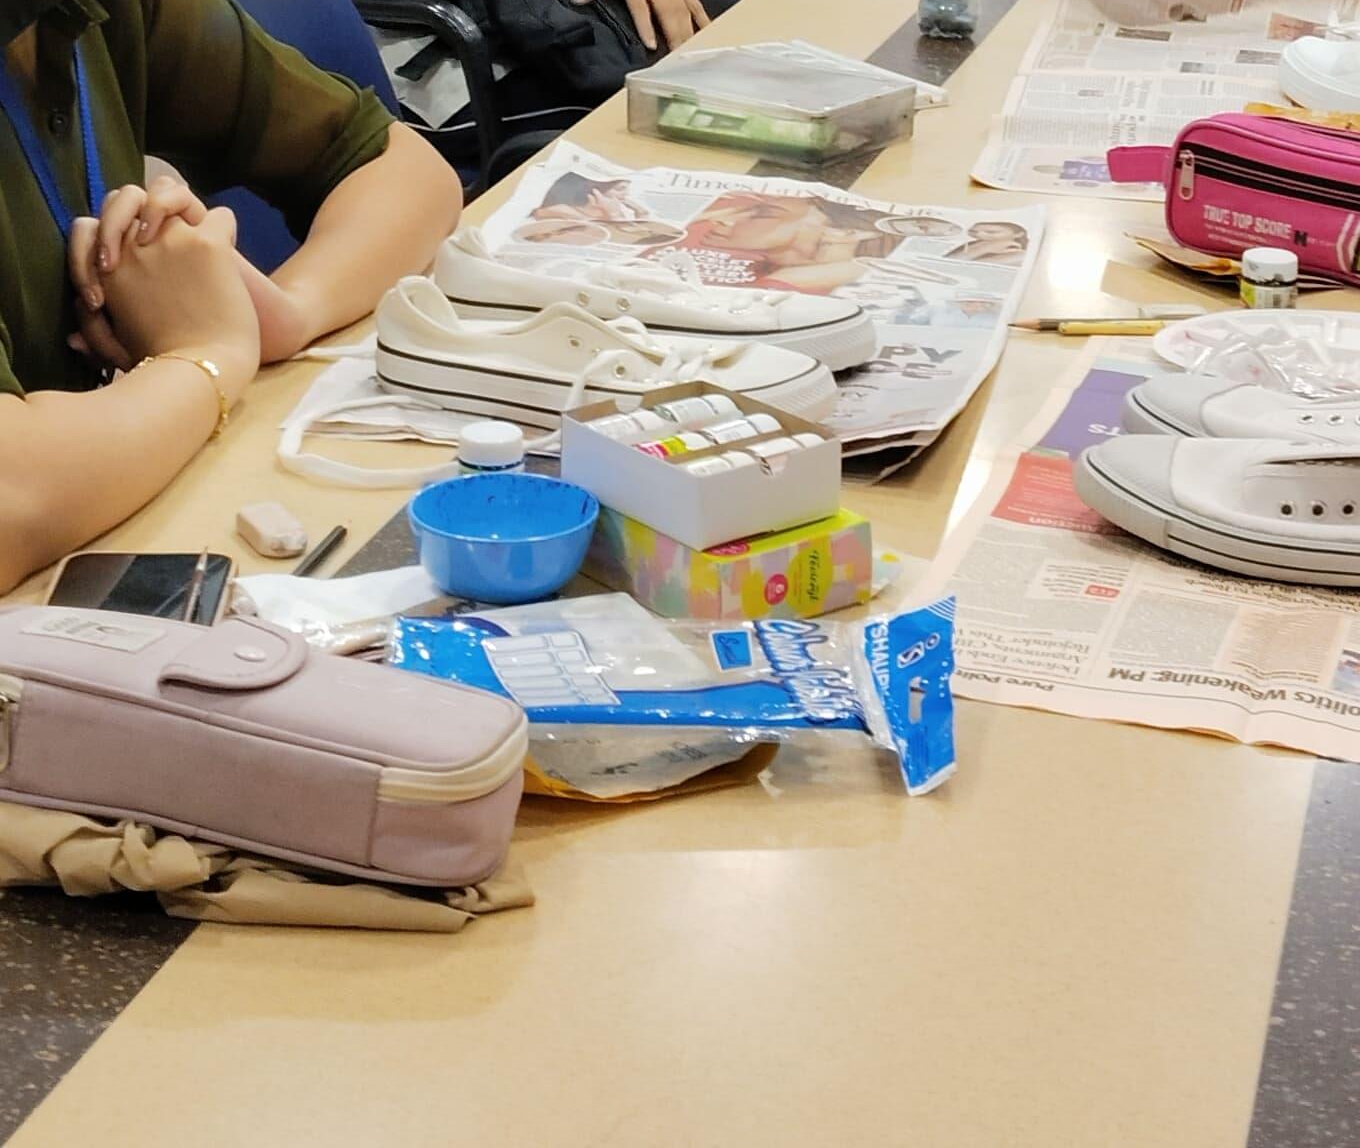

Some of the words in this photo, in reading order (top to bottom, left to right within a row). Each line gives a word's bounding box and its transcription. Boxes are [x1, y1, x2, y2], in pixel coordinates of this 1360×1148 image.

[1231, 211, 1254, 230] TOP
[877, 343, 963, 364] PY
[1106, 667, 1146, 683] PM
[1005, 677, 1056, 693] Pure
